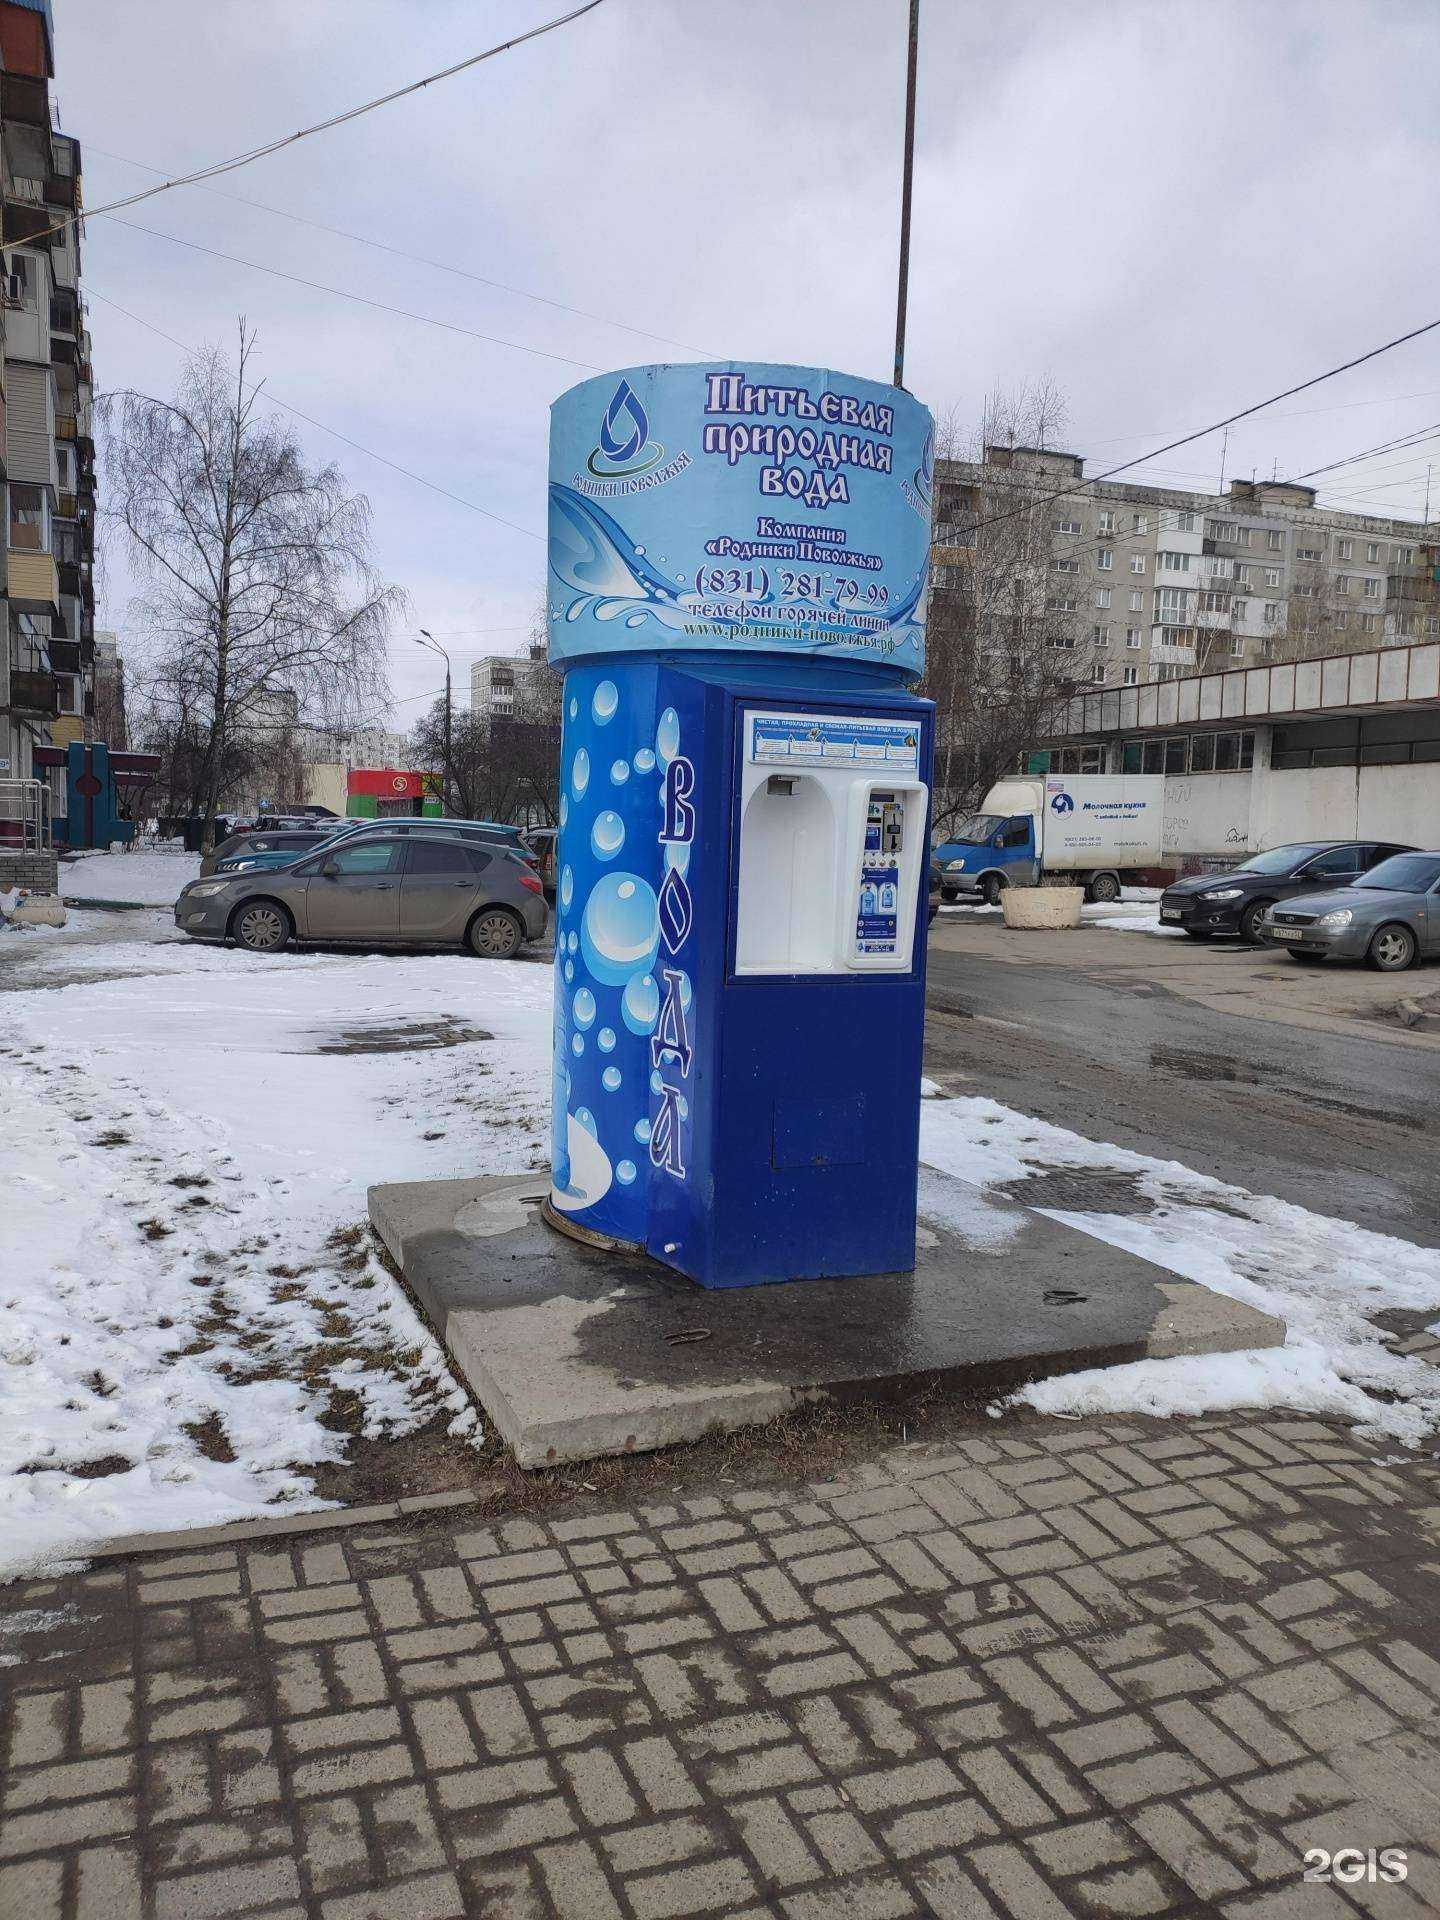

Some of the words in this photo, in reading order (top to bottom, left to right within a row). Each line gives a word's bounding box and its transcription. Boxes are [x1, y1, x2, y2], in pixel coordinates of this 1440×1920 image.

[706, 372, 894, 436] Питьевая
[703, 424, 894, 473] природная
[760, 465, 849, 509] вода
[757, 517, 846, 545] Компания
[704, 536, 795, 560] «Родники
[797, 541, 883, 571] Поволжья»
[695, 565, 770, 598] (831)
[780, 571, 889, 607] 281-79-99
